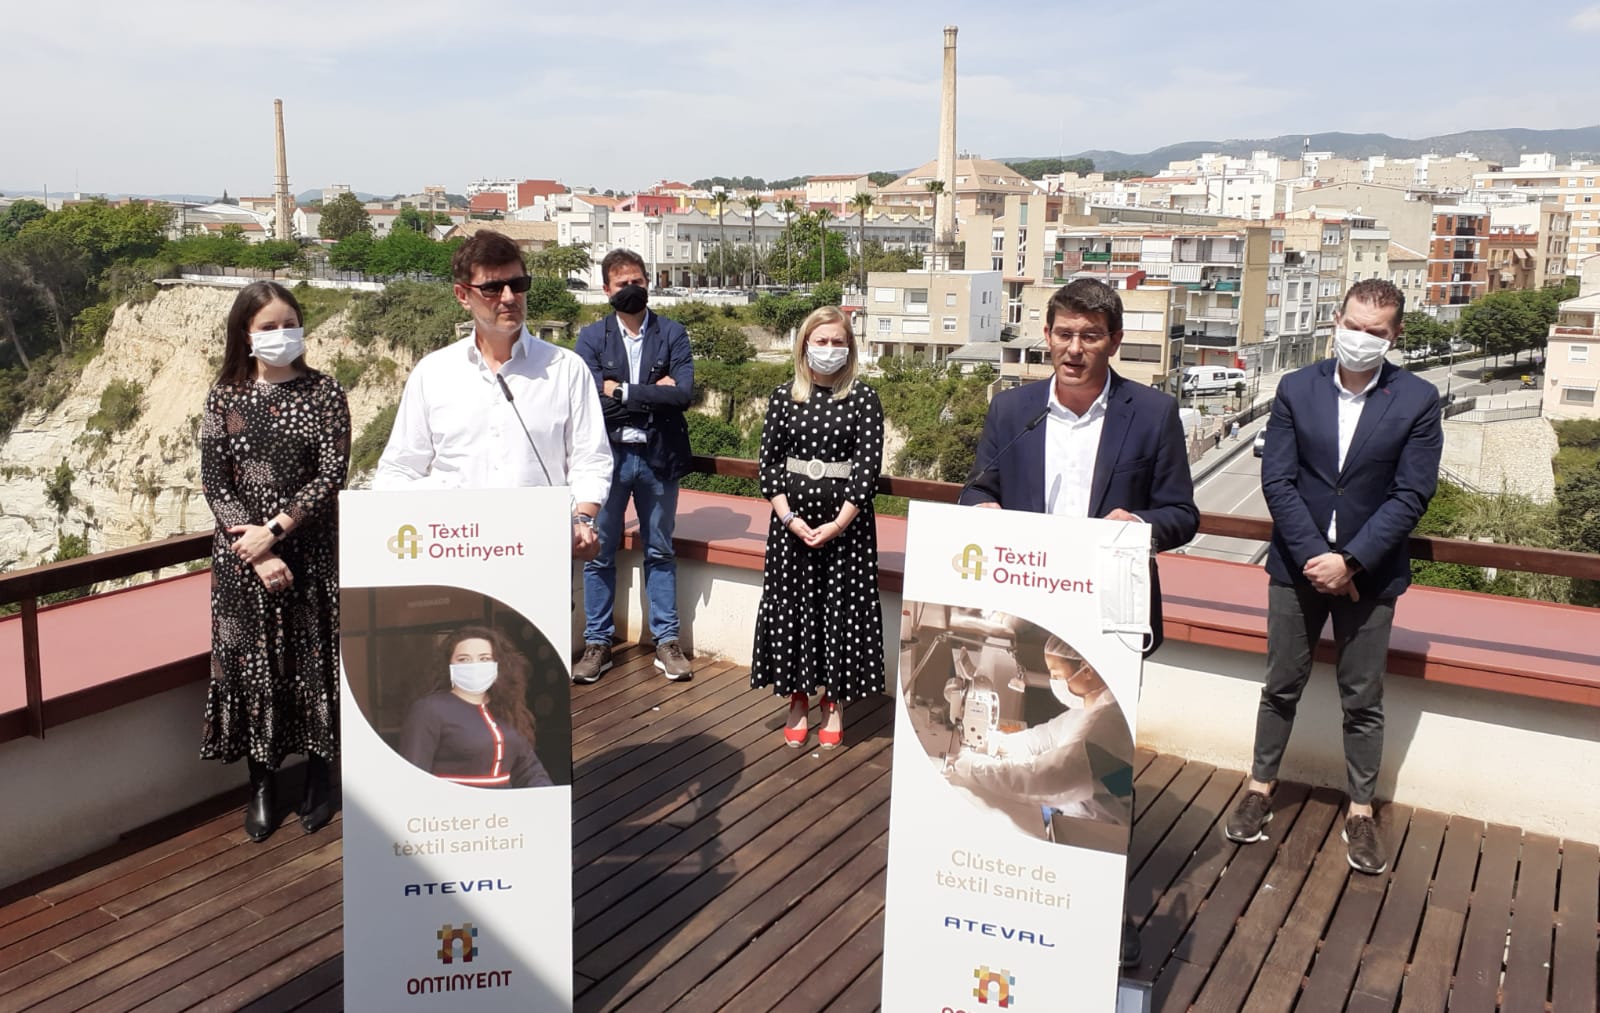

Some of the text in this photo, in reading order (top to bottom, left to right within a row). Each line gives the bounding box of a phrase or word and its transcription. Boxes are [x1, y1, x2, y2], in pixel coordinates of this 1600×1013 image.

[428, 523, 479, 539] Tèxtil
[428, 542, 524, 561] Ontinyent
[994, 546, 1047, 567] Tèxtil
[993, 568, 1094, 594] Ontinyent
[407, 814, 509, 833] Clúster de
[393, 833, 524, 857] tèxtil sanitari
[951, 850, 1057, 883] Clúster de
[404, 878, 512, 897] ATEVAL
[936, 871, 1071, 909] tèxtil sanitari
[944, 916, 1056, 948] ATEVAL
